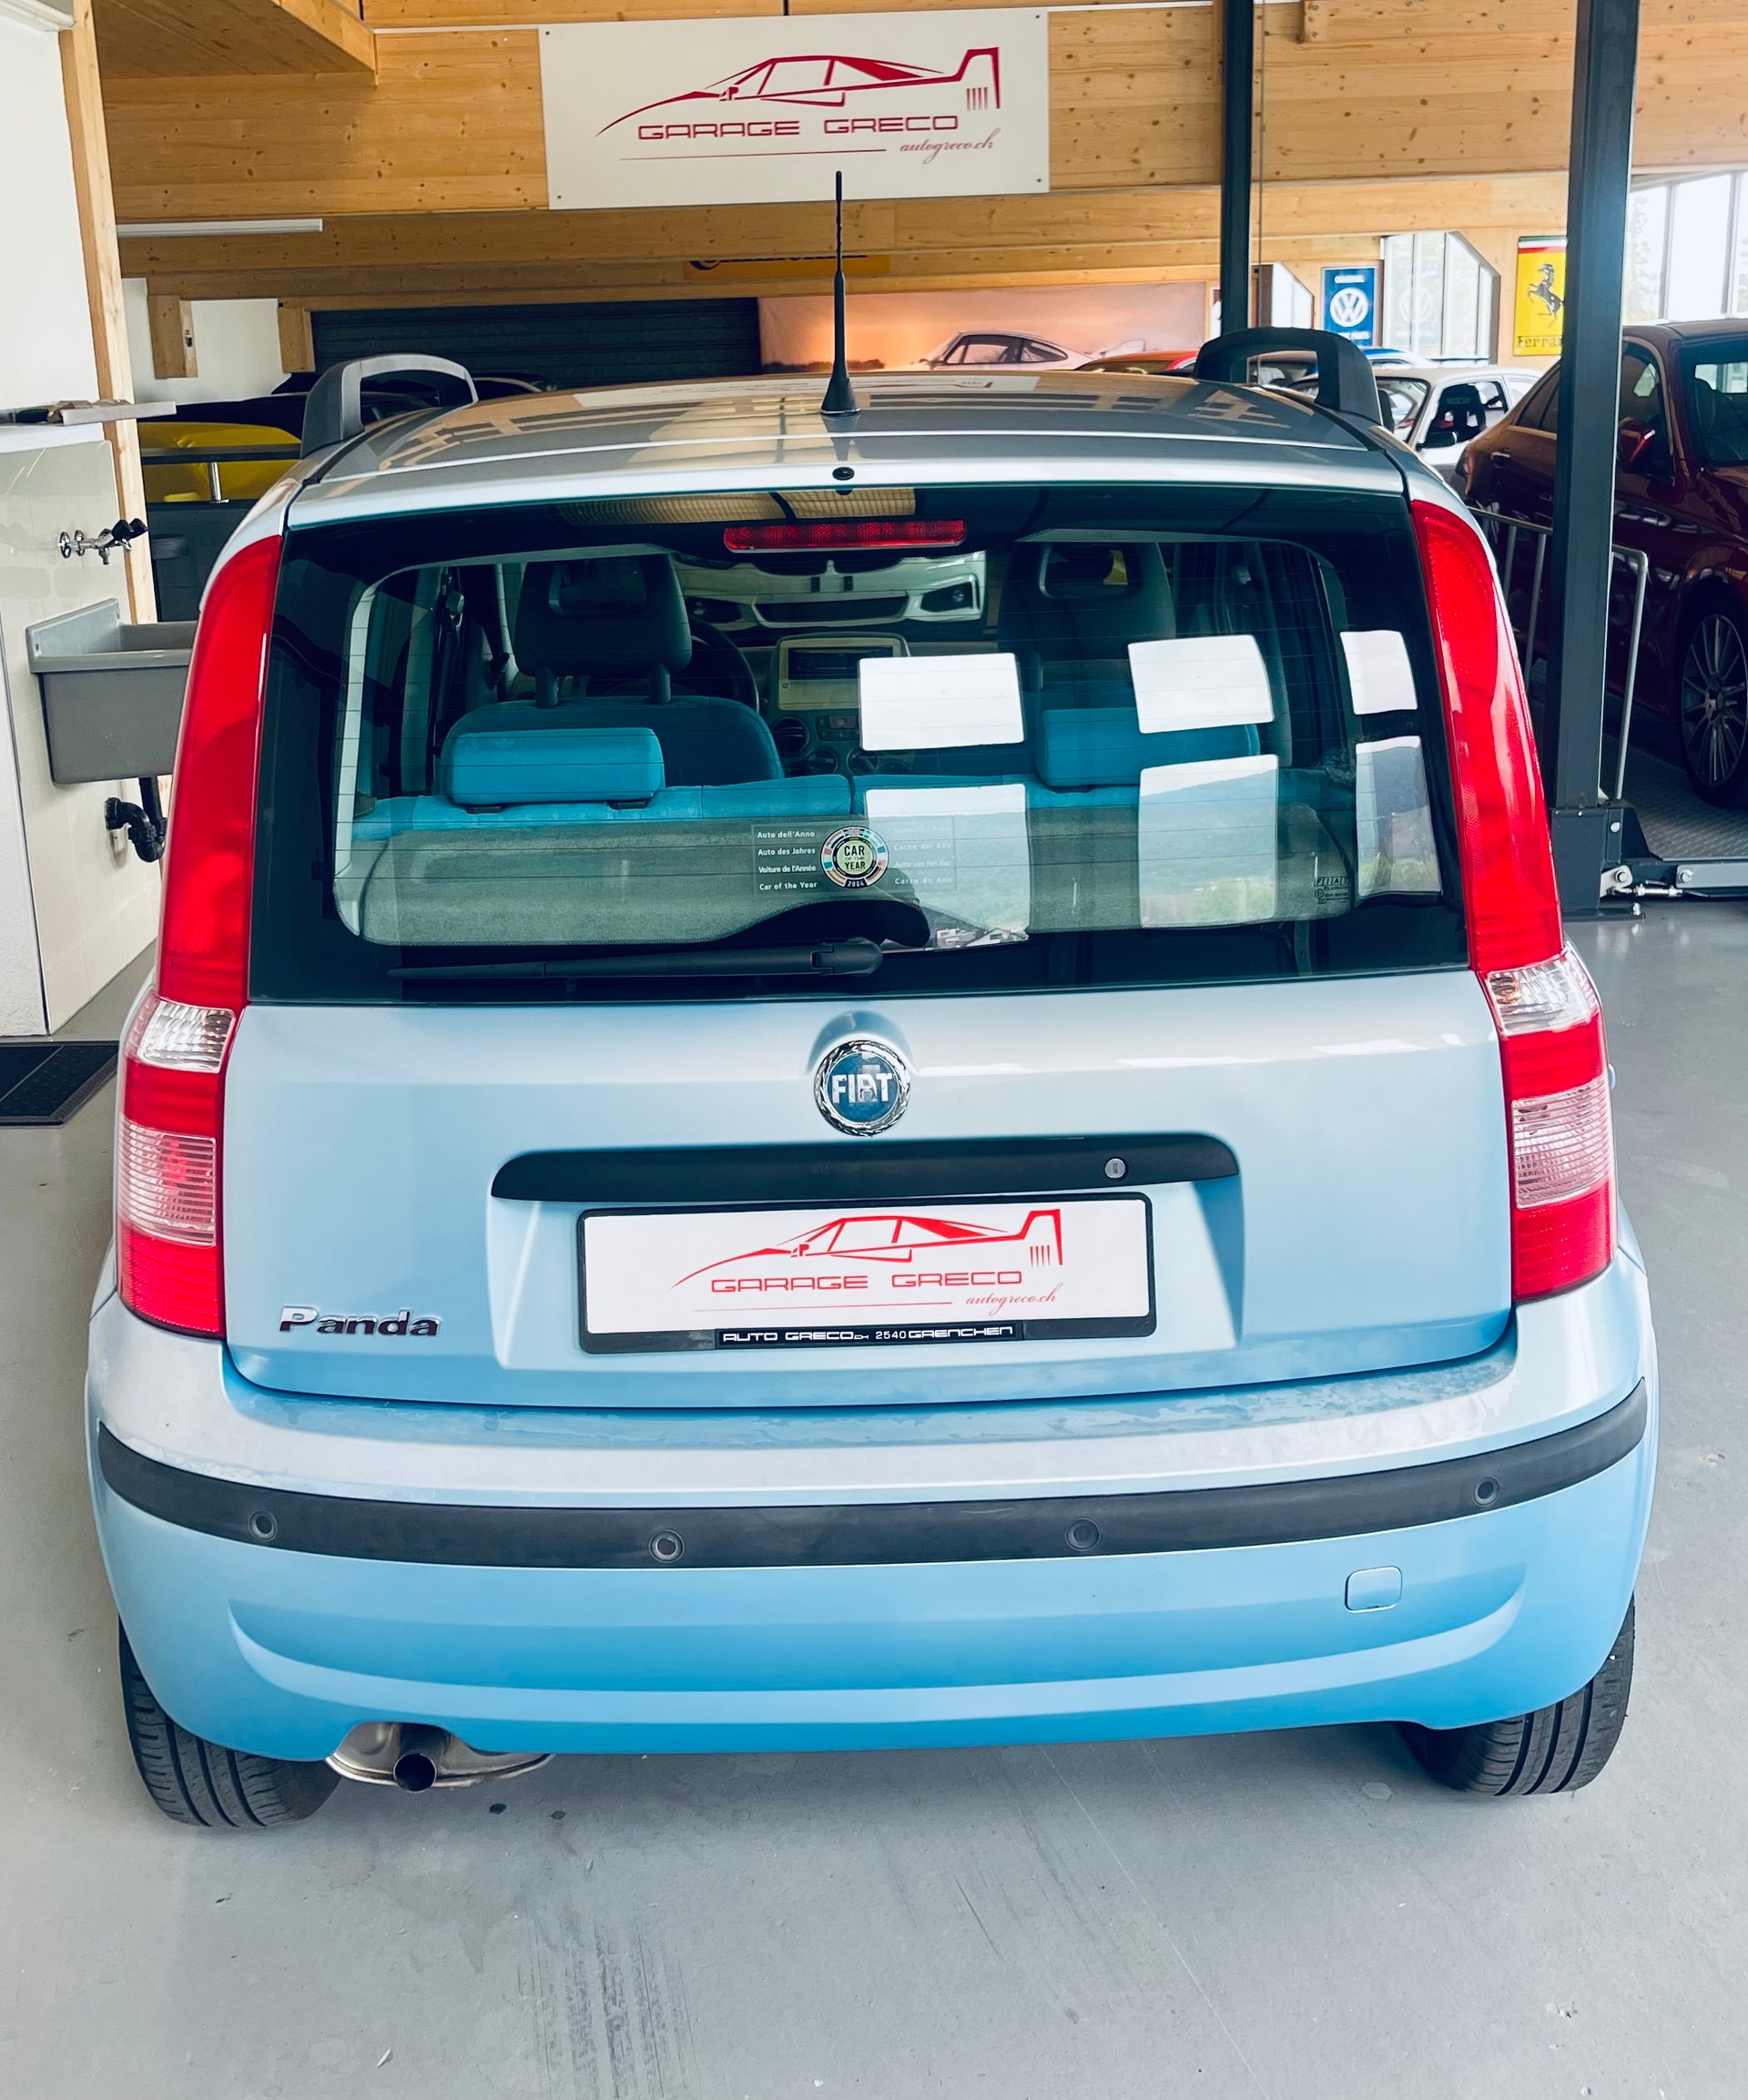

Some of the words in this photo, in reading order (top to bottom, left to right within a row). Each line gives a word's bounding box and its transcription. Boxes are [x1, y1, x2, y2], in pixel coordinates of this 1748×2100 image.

[637, 119, 800, 140] GARAGE
[824, 115, 959, 135] GRECO
[899, 127, 1001, 165] autogreco.ch
[844, 845, 865, 857] CAR
[844, 861, 866, 870] YEAR
[759, 883, 772, 891] Car
[831, 1072, 893, 1104] FIAT
[710, 1274, 869, 1293] GARAGE
[891, 1270, 1022, 1288] GRECO
[965, 1282, 1063, 1317] autogreco.ch
[279, 1305, 441, 1336] Panda
[723, 1332, 778, 1343] AUTO
[875, 1330, 907, 1340] 2540
[908, 1326, 1013, 1339] GRENCHEN
